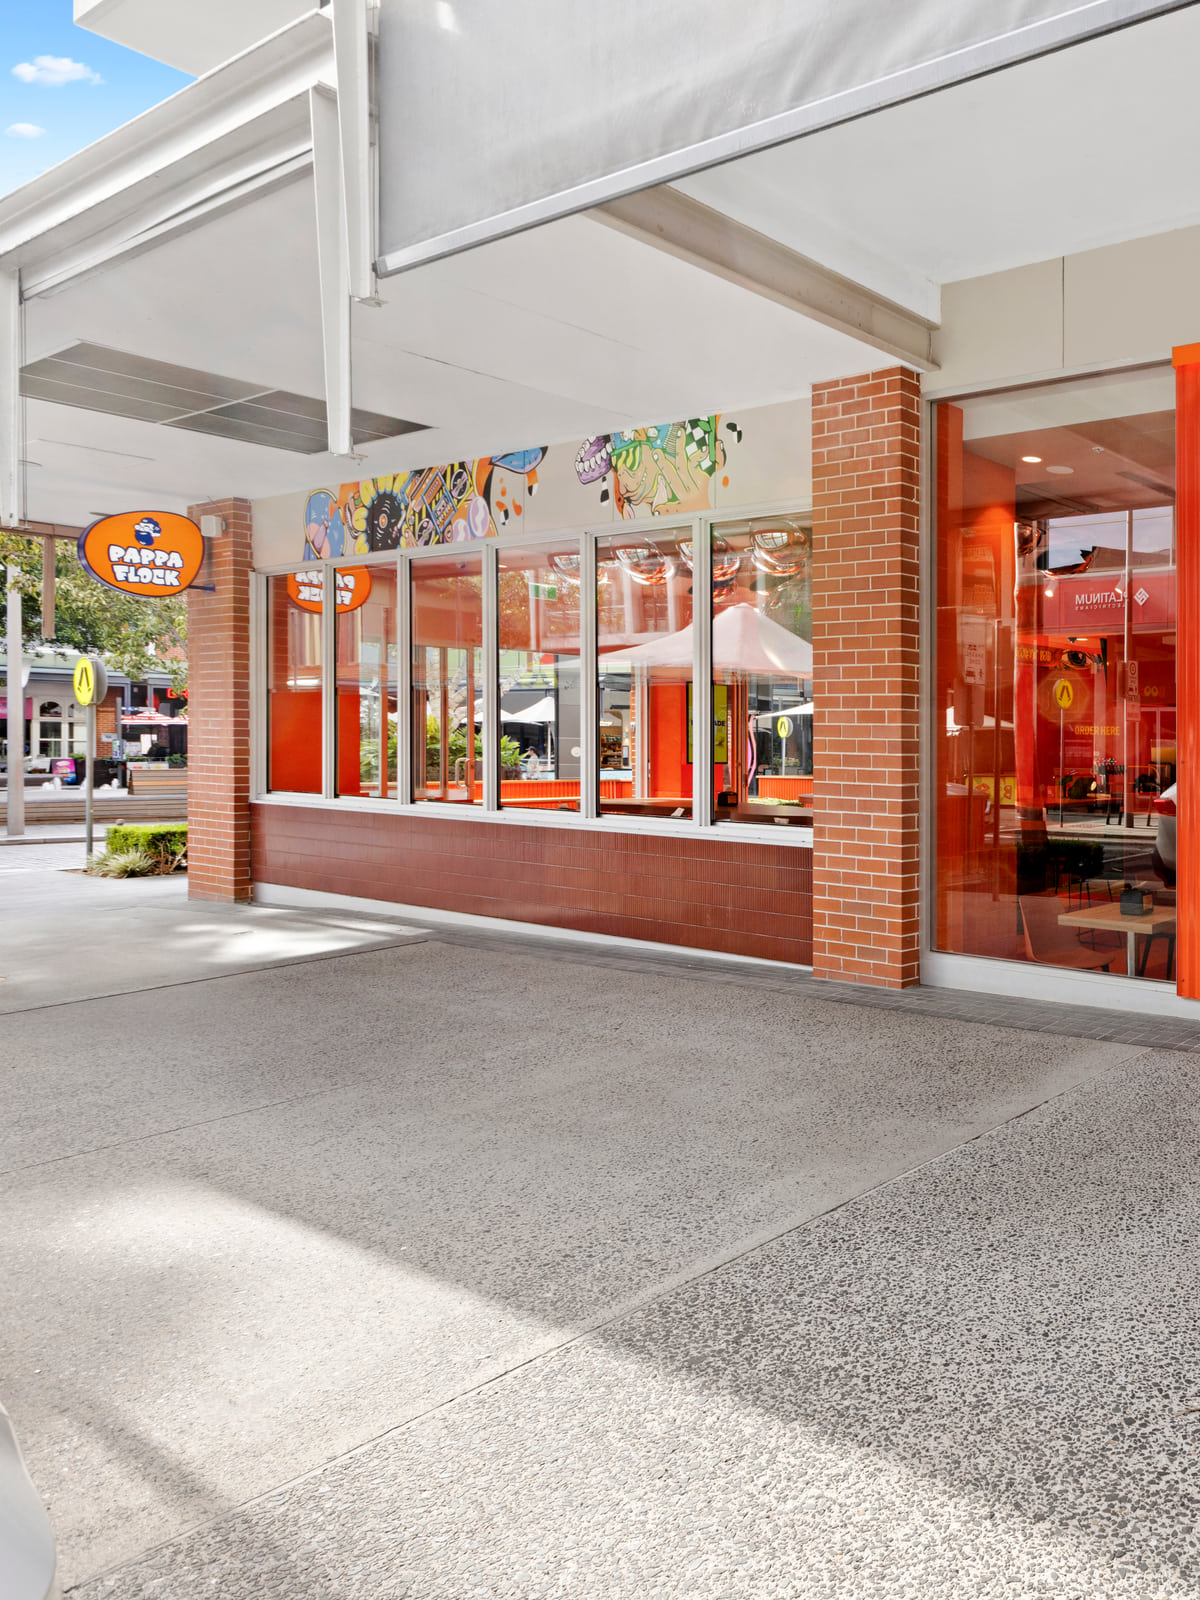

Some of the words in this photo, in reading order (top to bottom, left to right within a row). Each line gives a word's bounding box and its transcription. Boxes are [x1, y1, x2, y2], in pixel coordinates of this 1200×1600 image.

[108, 544, 184, 568] PAPPA
[112, 564, 181, 587] FLOCK
[1074, 725, 1099, 735] ORDER
[1101, 726, 1120, 736] HERE
